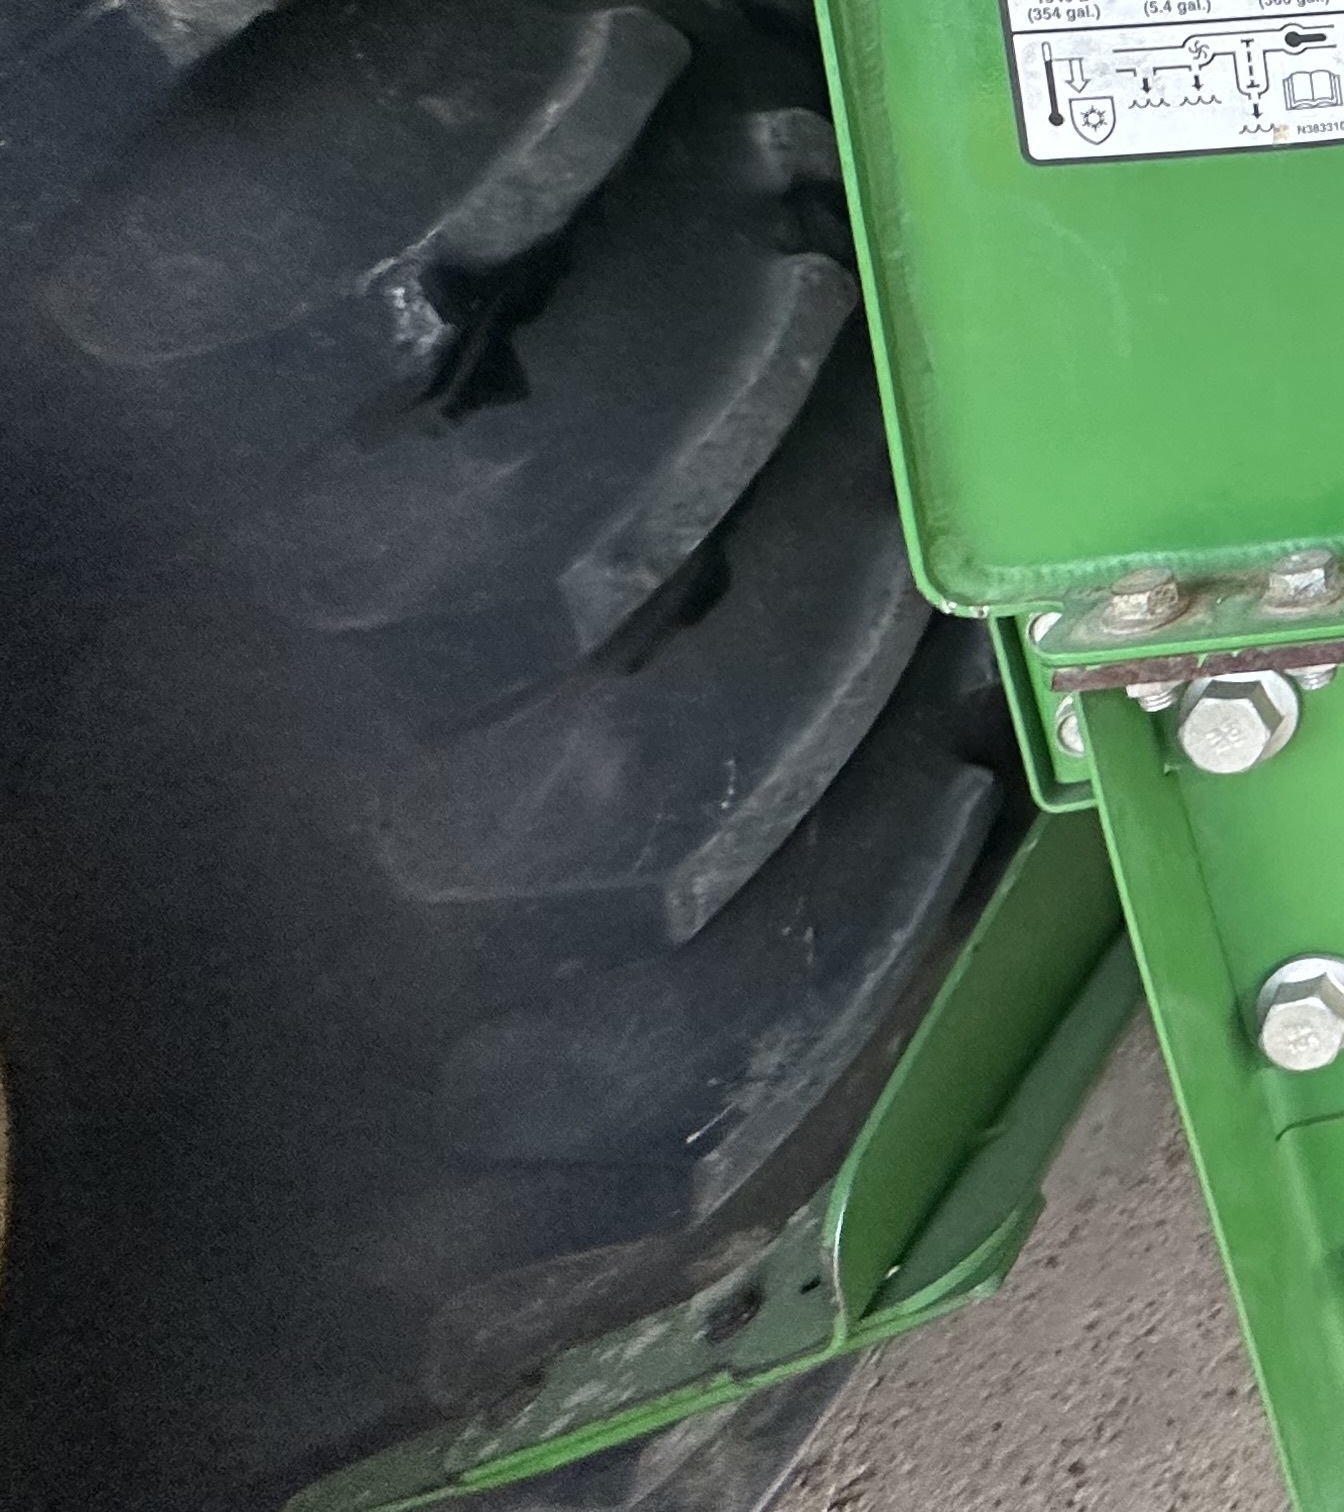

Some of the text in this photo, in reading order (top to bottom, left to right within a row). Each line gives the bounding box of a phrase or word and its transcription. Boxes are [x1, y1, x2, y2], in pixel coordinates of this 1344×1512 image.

[1027, 3, 1101, 24] (354 gal.)
[1143, 0, 1172, 18] (5.4
